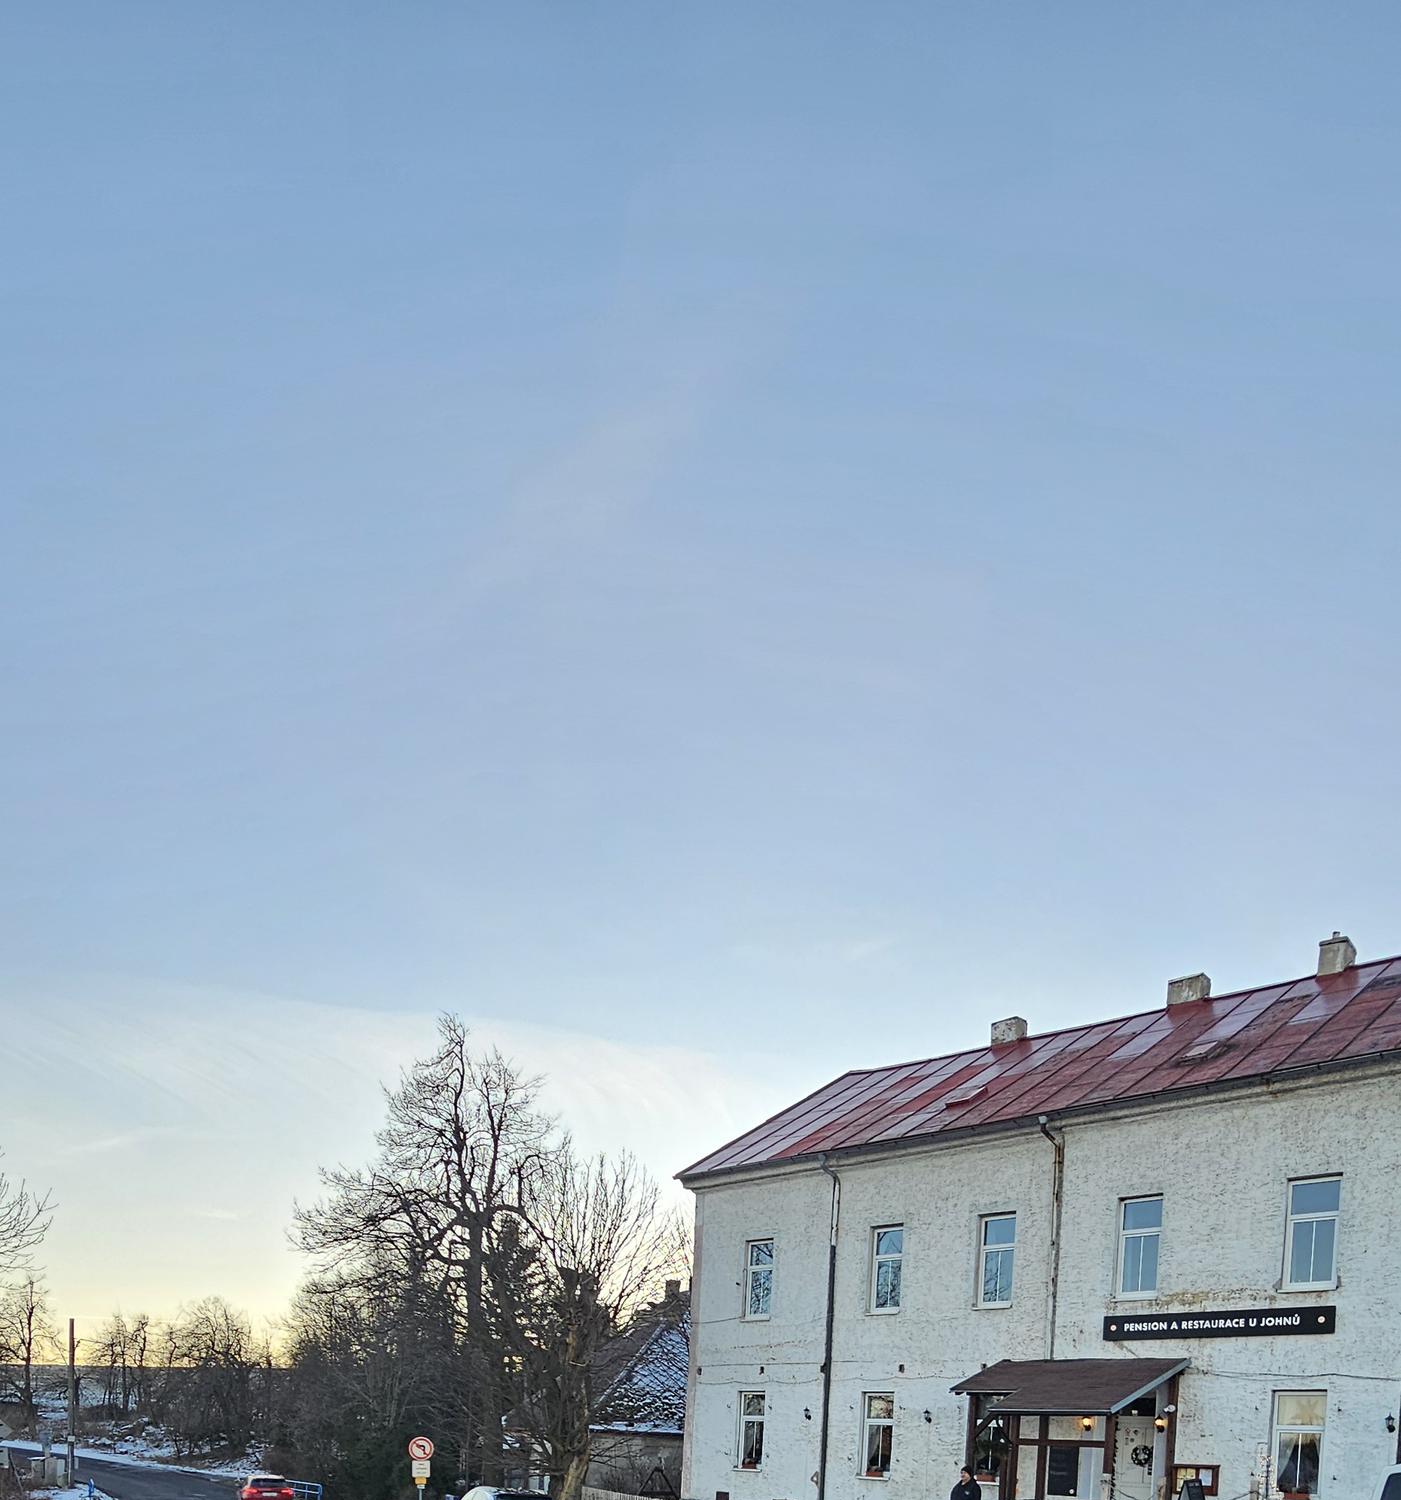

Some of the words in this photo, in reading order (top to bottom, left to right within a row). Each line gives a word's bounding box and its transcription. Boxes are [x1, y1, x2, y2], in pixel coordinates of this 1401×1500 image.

[1123, 1321, 1168, 1332] PENSION
[1170, 1320, 1179, 1330] A
[1181, 1318, 1246, 1330] RESTAURACE
[1248, 1317, 1257, 1327] U
[1259, 1313, 1301, 1326] JOHNŮ
